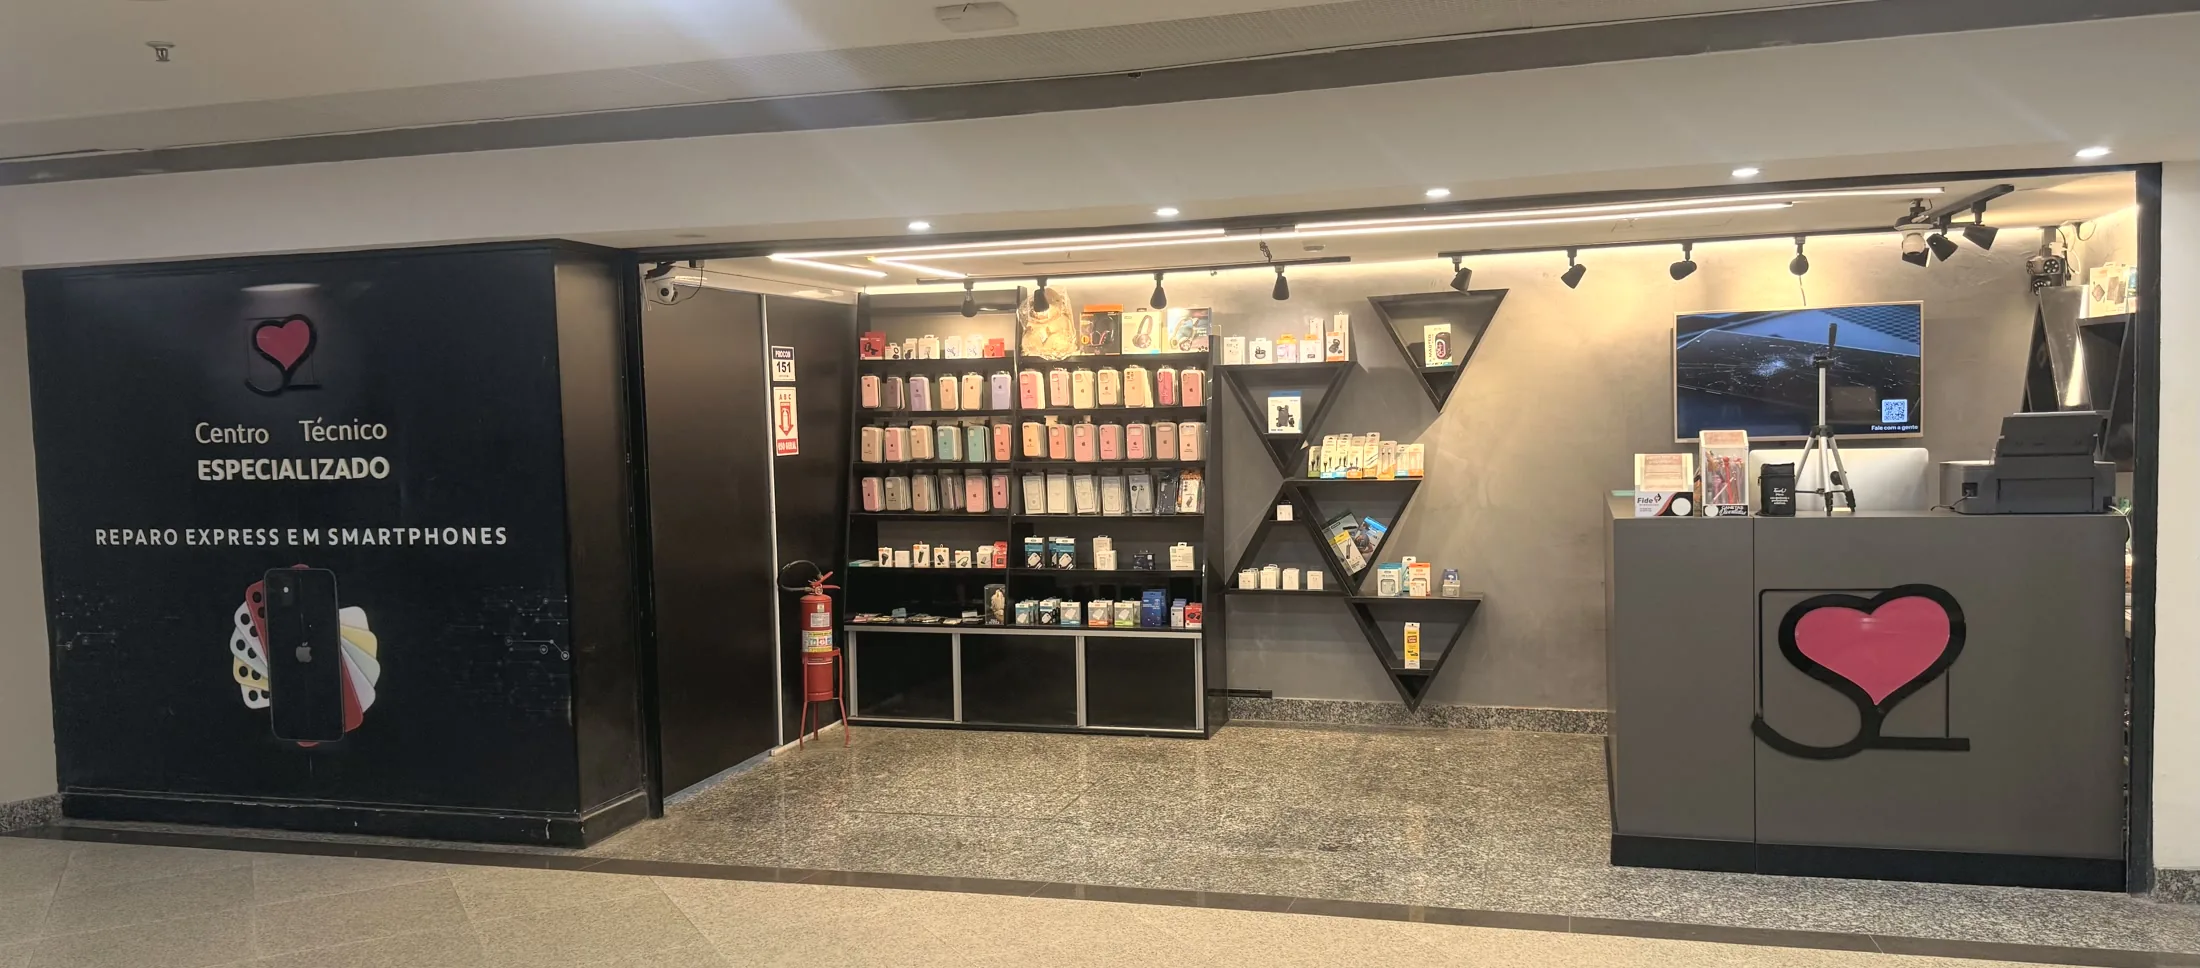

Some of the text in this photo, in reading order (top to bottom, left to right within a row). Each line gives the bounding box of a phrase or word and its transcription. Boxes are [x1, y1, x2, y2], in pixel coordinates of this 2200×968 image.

[776, 361, 791, 373] 151
[195, 417, 388, 444] Centro Técnico
[197, 456, 391, 481] ESPECIALIZADO
[95, 526, 507, 545] REPARO EXPRESS EM SMARTPHONES
